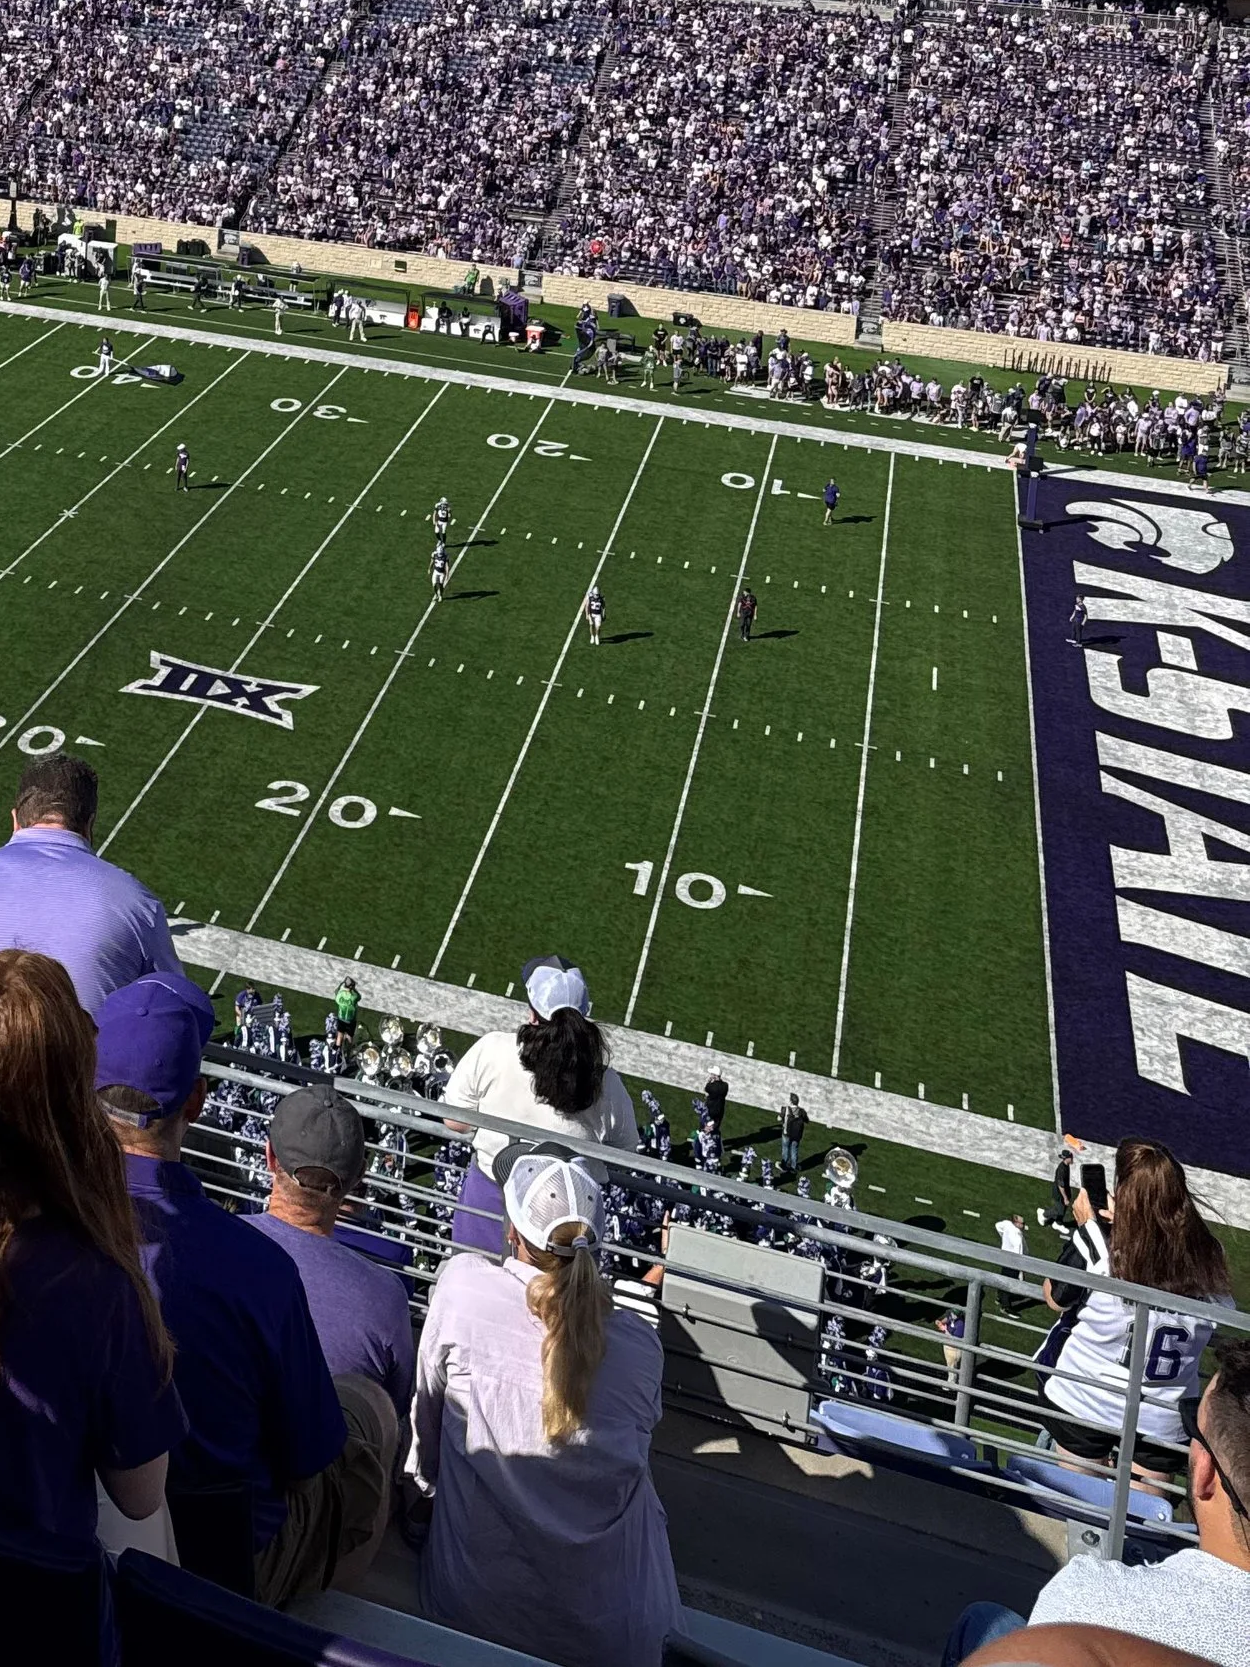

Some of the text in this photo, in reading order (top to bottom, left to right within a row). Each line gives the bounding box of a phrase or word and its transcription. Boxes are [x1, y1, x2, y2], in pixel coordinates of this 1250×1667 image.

[70, 365, 143, 385] 40
[270, 397, 347, 420] 30
[486, 433, 570, 457] 20
[721, 472, 791, 495] 10
[254, 780, 378, 829] 20
[624, 860, 727, 910] 10
